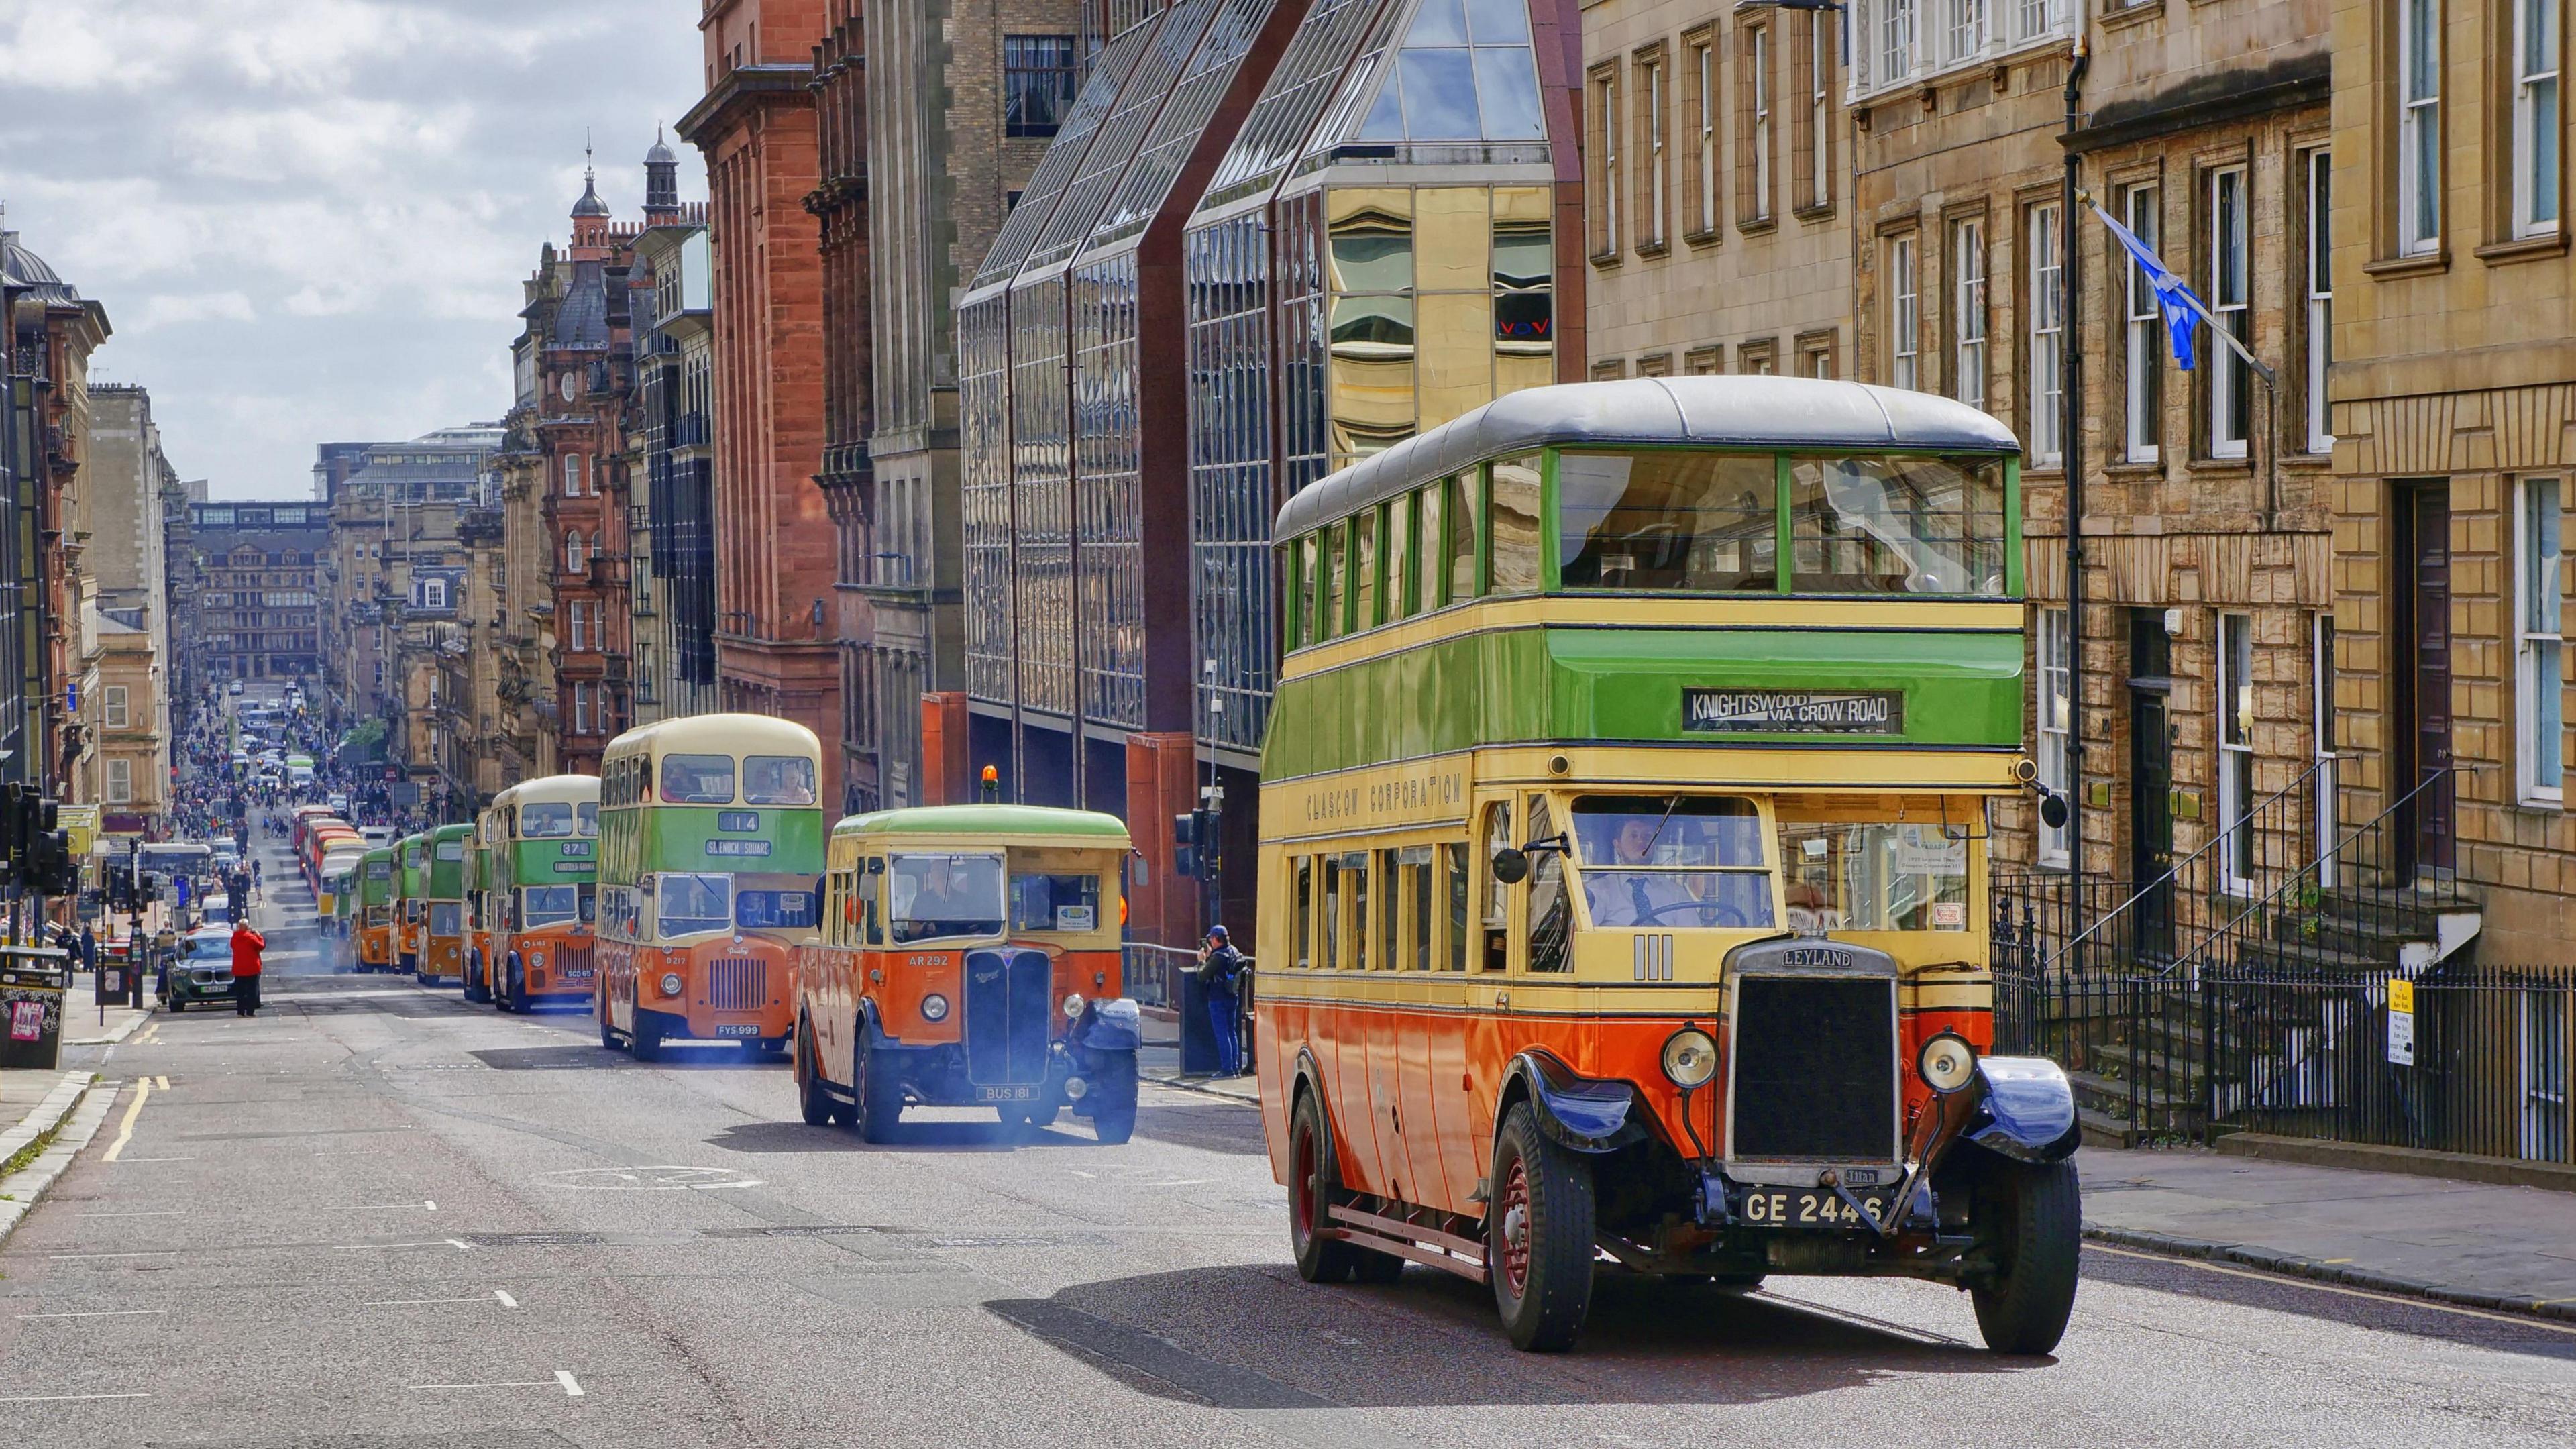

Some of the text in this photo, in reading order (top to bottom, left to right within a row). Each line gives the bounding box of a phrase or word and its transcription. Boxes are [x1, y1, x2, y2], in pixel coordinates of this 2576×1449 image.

[1693, 694, 1807, 720] KNIGHTSWOOD
[1770, 697, 1888, 722] VIA CROW ROAD
[1370, 773, 1460, 812] CORPORATION
[736, 816, 755, 830] 14
[563, 843, 578, 853] 37
[719, 842, 739, 854] ENOCH
[745, 842, 768, 855] SQUARE
[909, 956, 948, 966] AR 292
[1784, 949, 1851, 967] LEYLAND
[719, 1026, 757, 1034] FYS 999
[987, 1087, 1029, 1099] BUS 181
[1747, 1194, 1882, 1222] GE 2446
